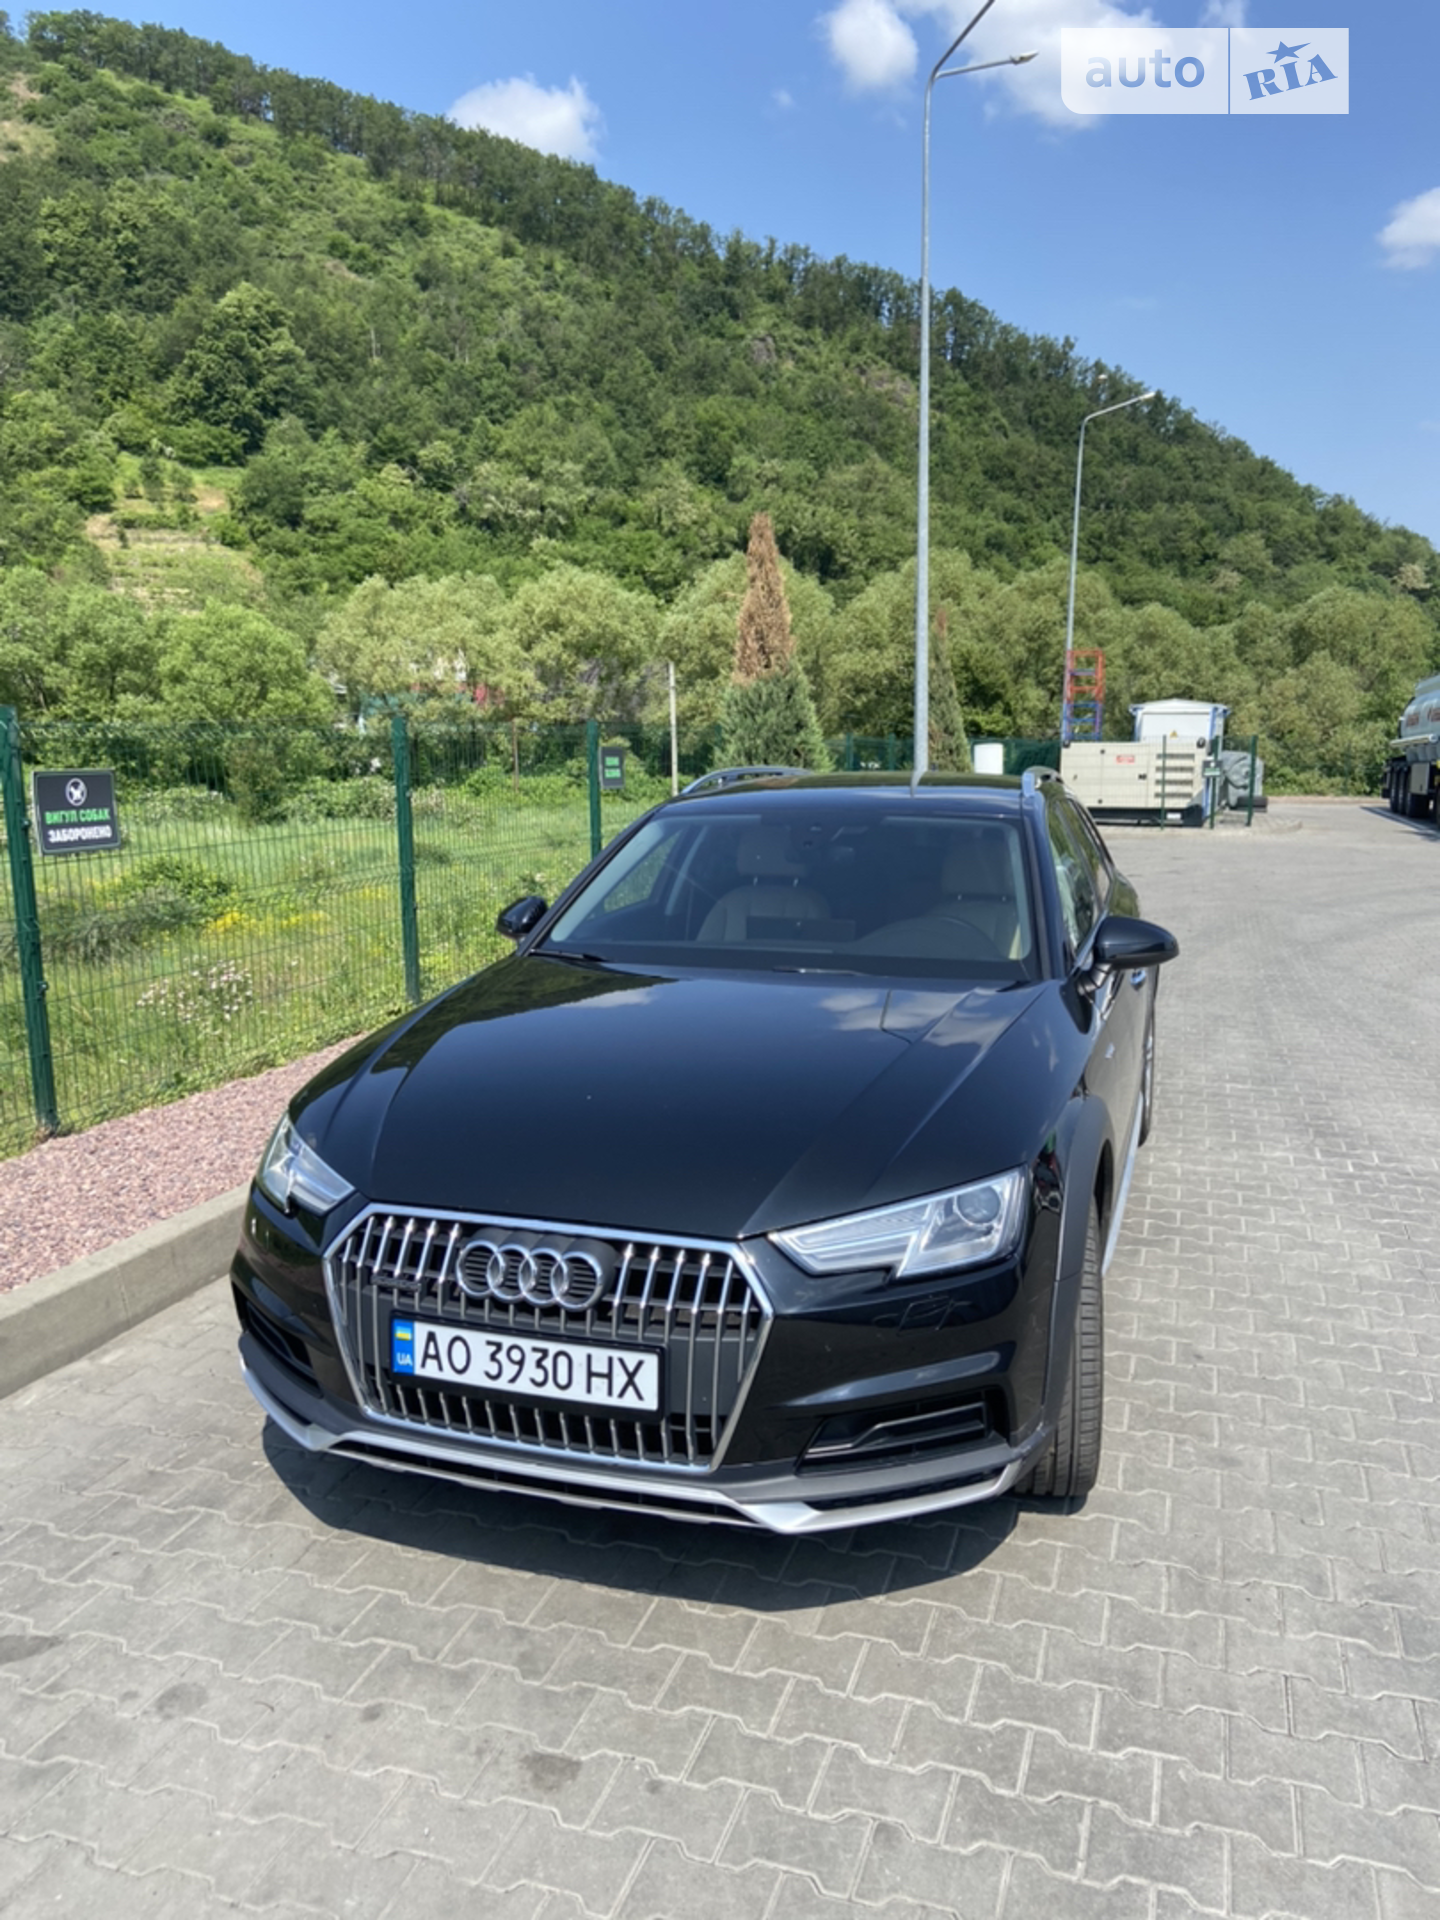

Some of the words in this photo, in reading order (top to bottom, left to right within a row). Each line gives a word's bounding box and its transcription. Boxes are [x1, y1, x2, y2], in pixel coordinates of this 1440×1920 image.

[45, 810, 79, 825] ВИГУЛ
[80, 808, 111, 822] СОБАК
[48, 825, 112, 843] ЗАБОРОНЕНО
[397, 1352, 413, 1366] UA
[420, 1331, 471, 1375] AO
[484, 1340, 573, 1391] 3930
[586, 1353, 645, 1401] HX
